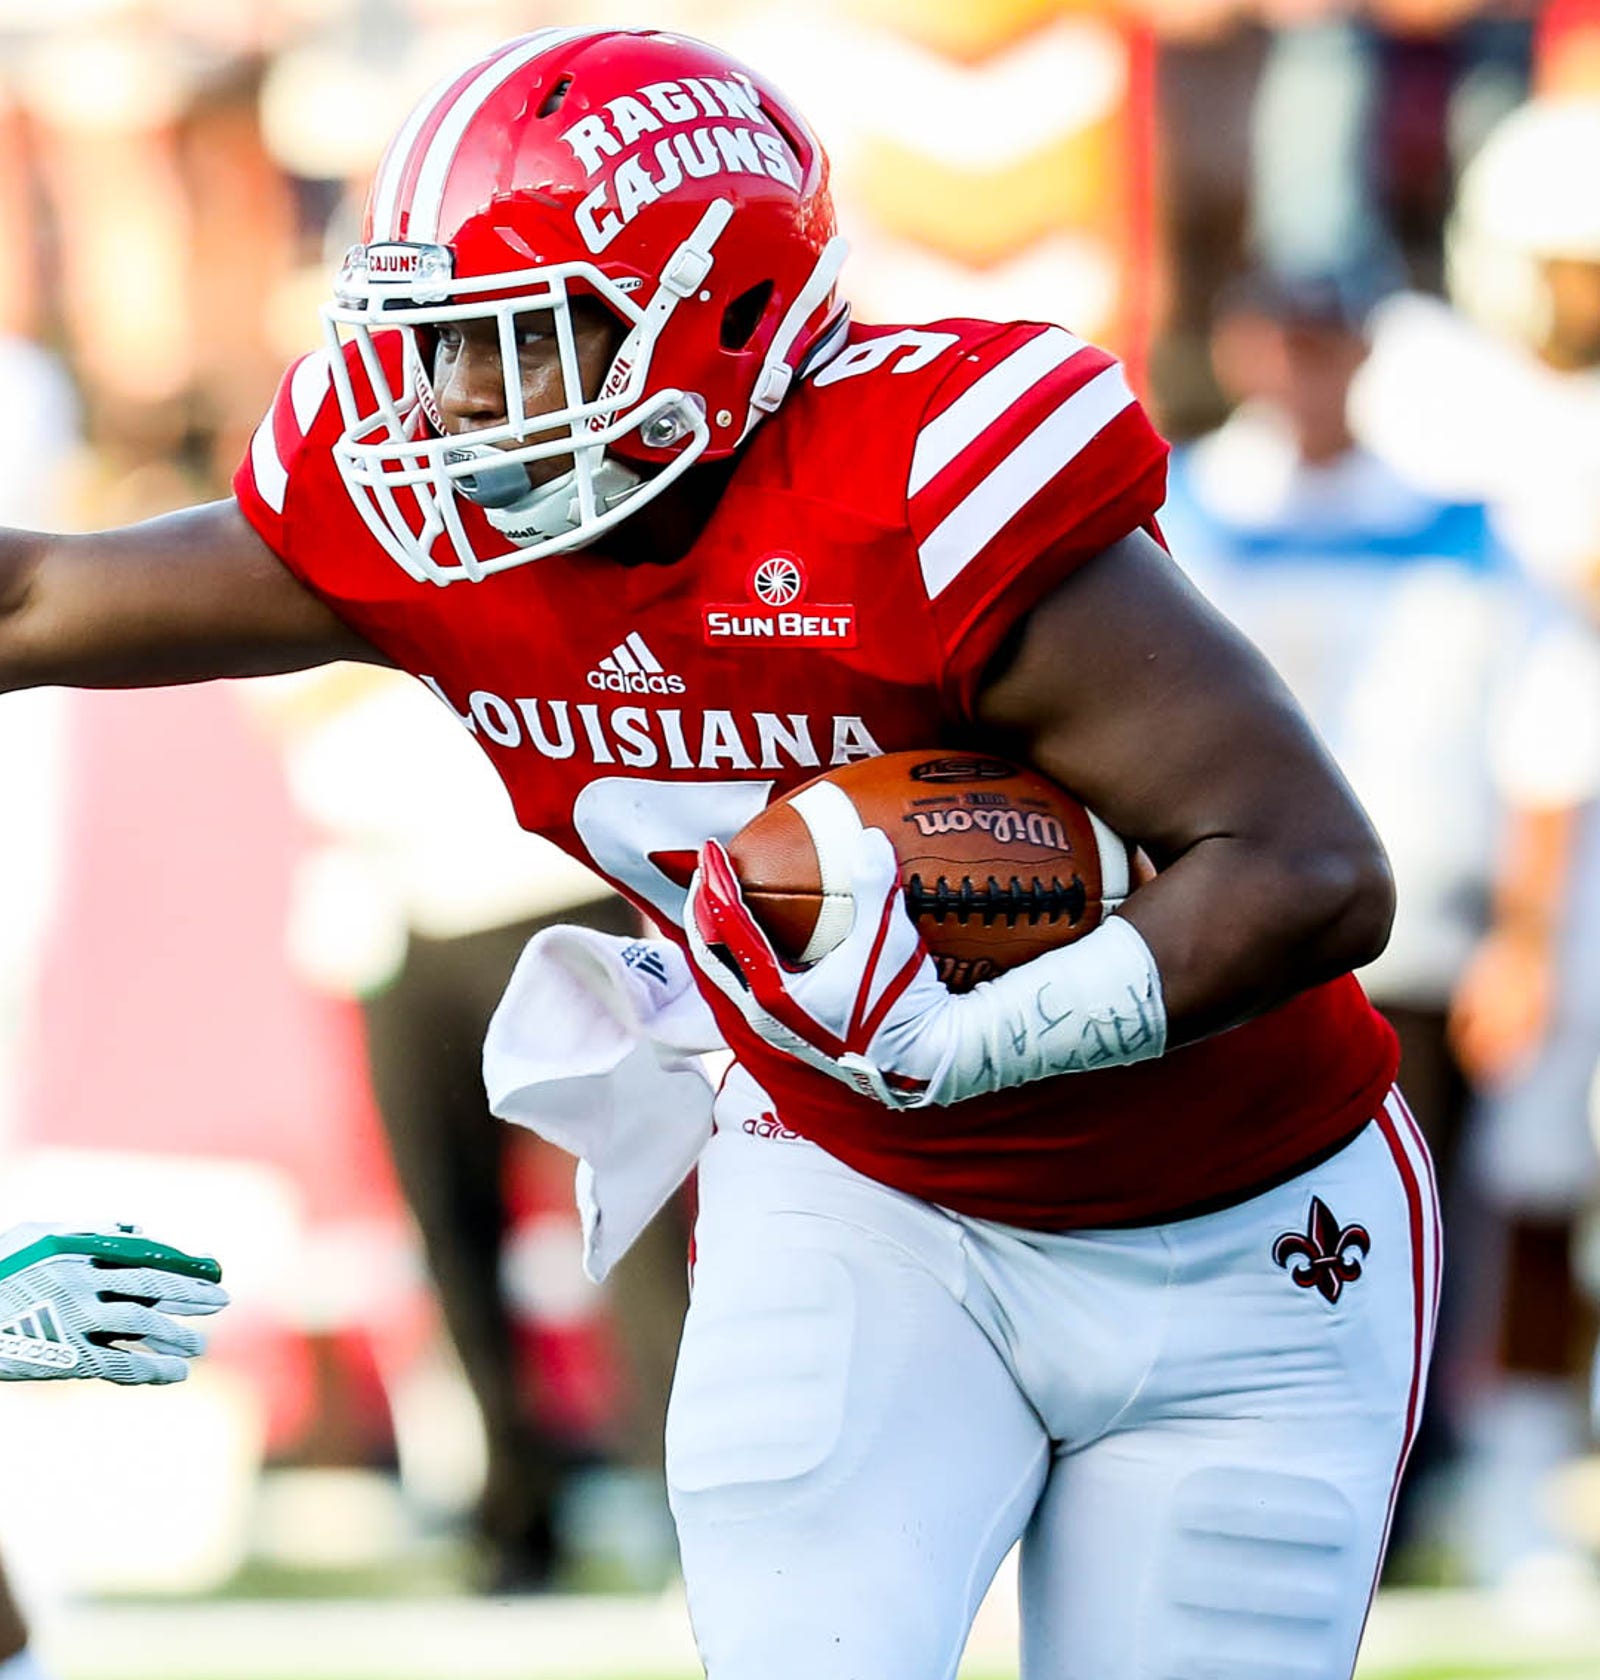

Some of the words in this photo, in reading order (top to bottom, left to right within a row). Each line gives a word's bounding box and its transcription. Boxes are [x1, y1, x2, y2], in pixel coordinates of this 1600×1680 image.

[574, 126, 802, 254] CAJUNS
[813, 328, 961, 387] 9
[708, 612, 774, 637] SUN
[778, 612, 851, 637] BELT
[587, 668, 686, 694] adidas
[419, 674, 887, 770] LOUISIANA
[903, 809, 1073, 851] Wilson
